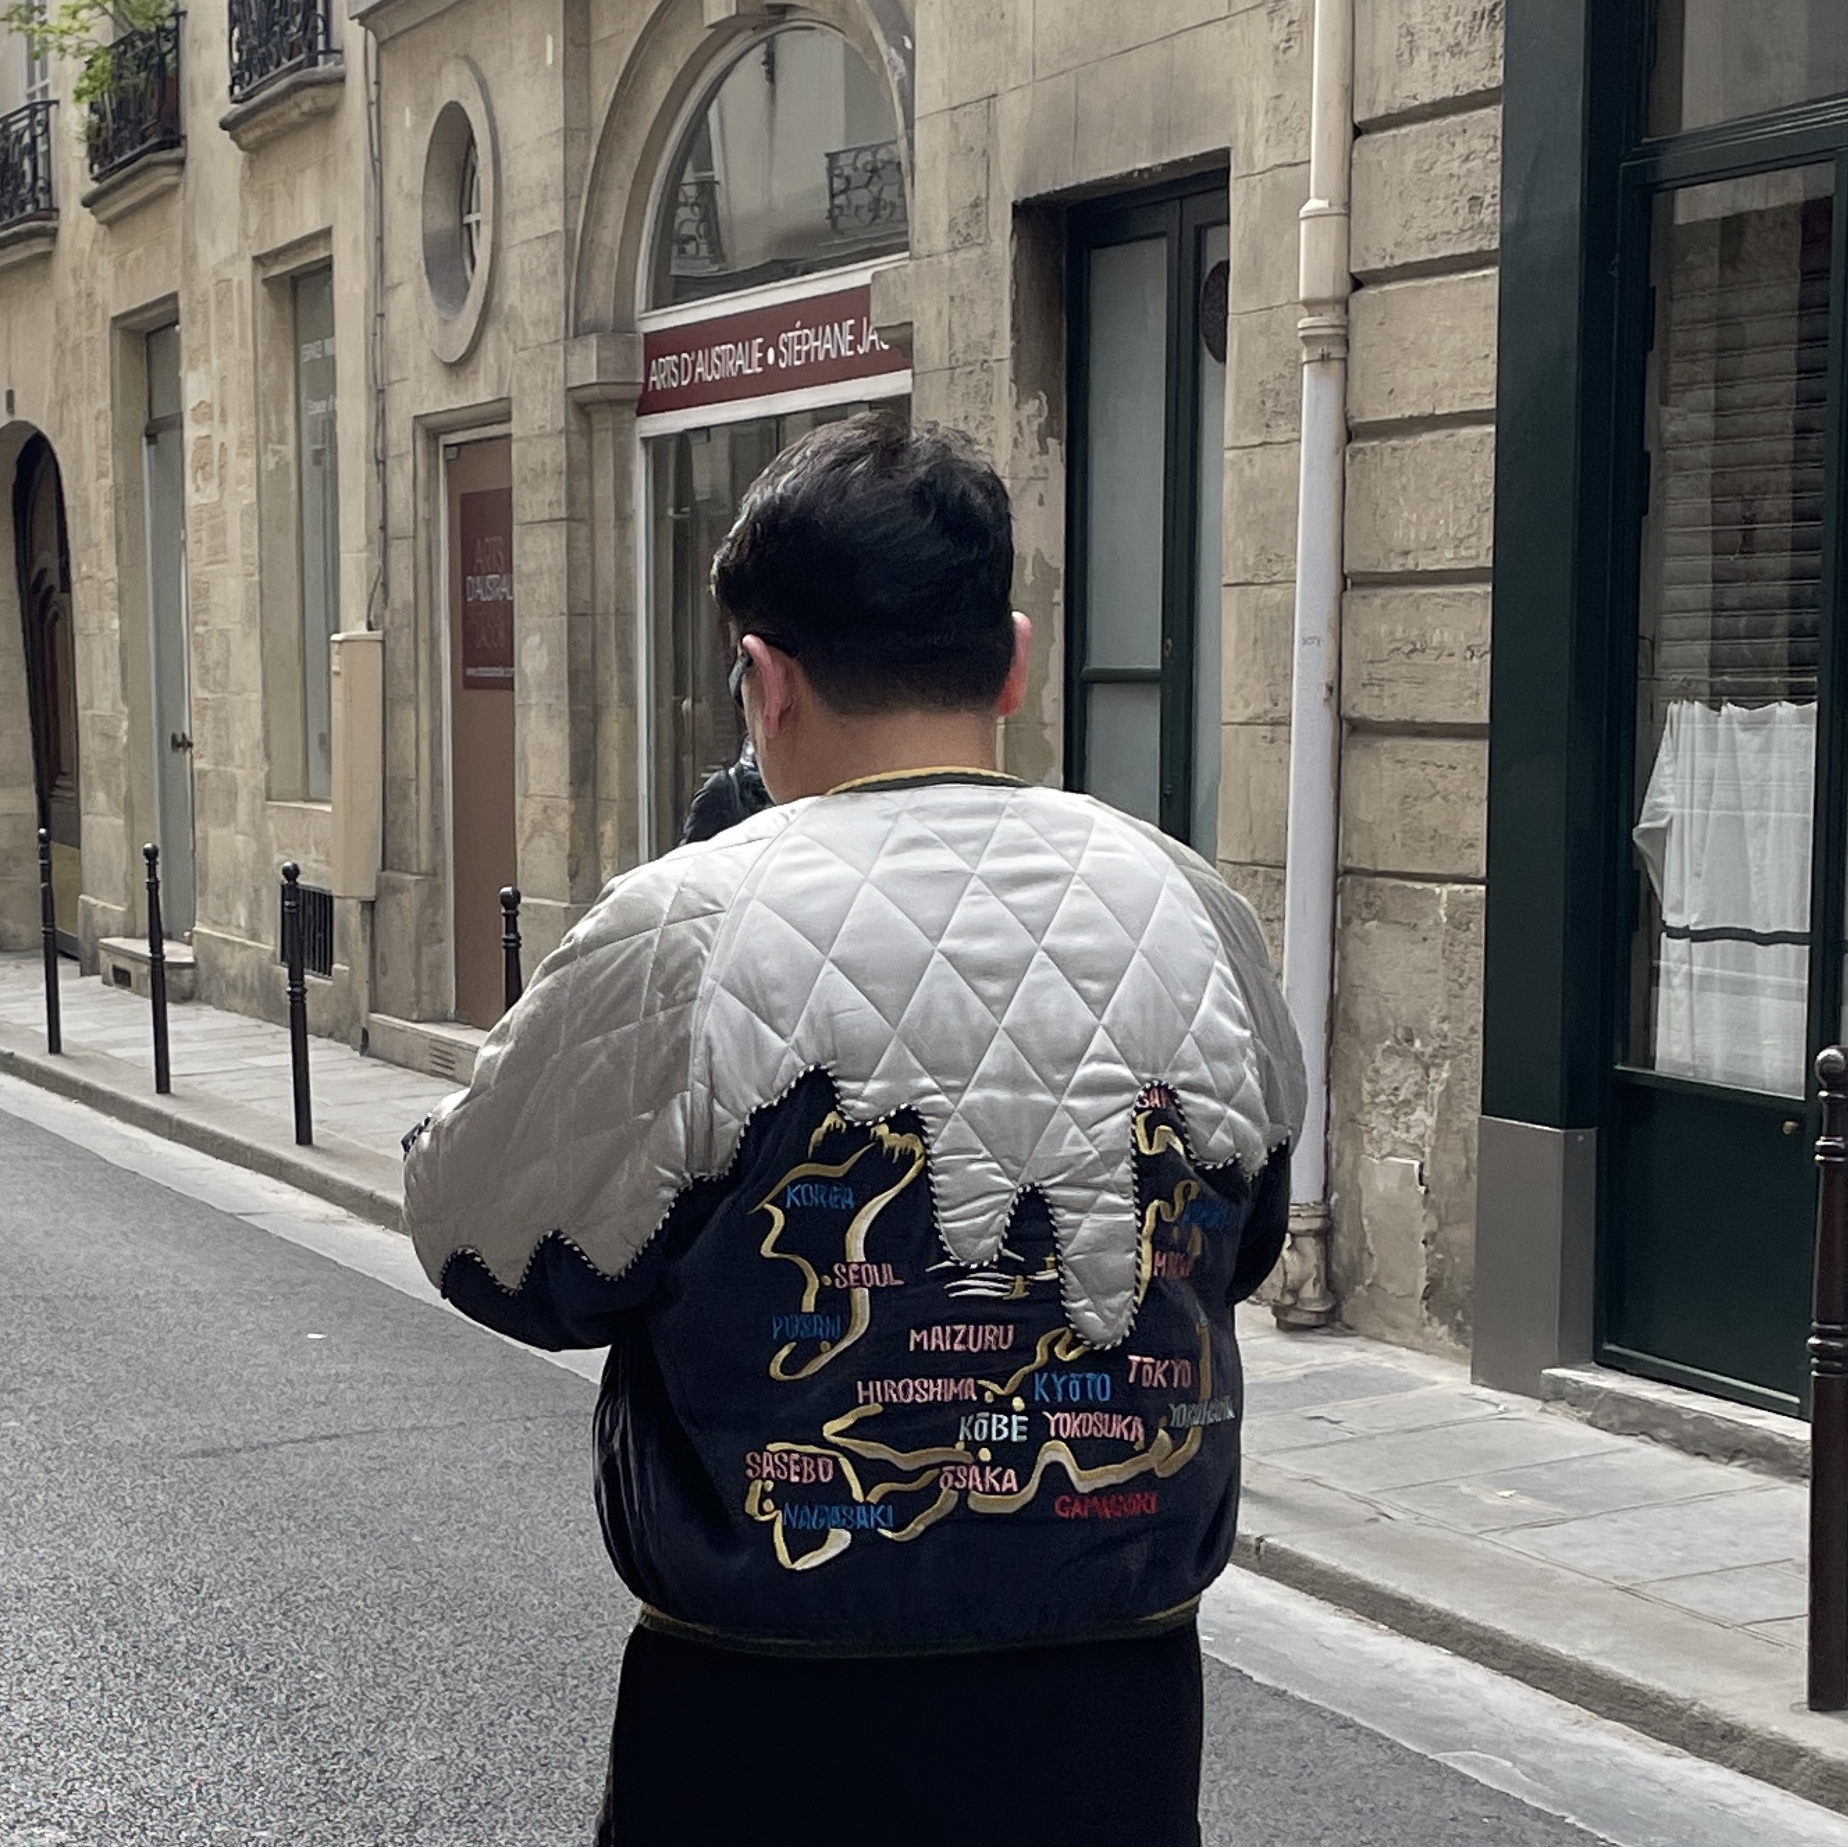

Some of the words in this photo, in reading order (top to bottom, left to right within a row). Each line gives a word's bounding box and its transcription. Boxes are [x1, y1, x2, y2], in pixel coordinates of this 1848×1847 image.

[648, 355, 680, 391] ARTS
[681, 338, 764, 385] D'AUSTRALIE
[779, 319, 855, 369] STÉPHANE
[857, 317, 890, 354] JA
[785, 1183, 855, 1210] KOREA
[833, 1262, 905, 1289] SEOUL
[909, 1324, 1015, 1352] MAIZURU
[857, 1376, 978, 1404] HIROSHIMA
[1042, 1411, 1145, 1443] YOKOSUKA
[745, 1451, 834, 1483] SASEBO
[783, 1502, 894, 1530] NAGASAKI
